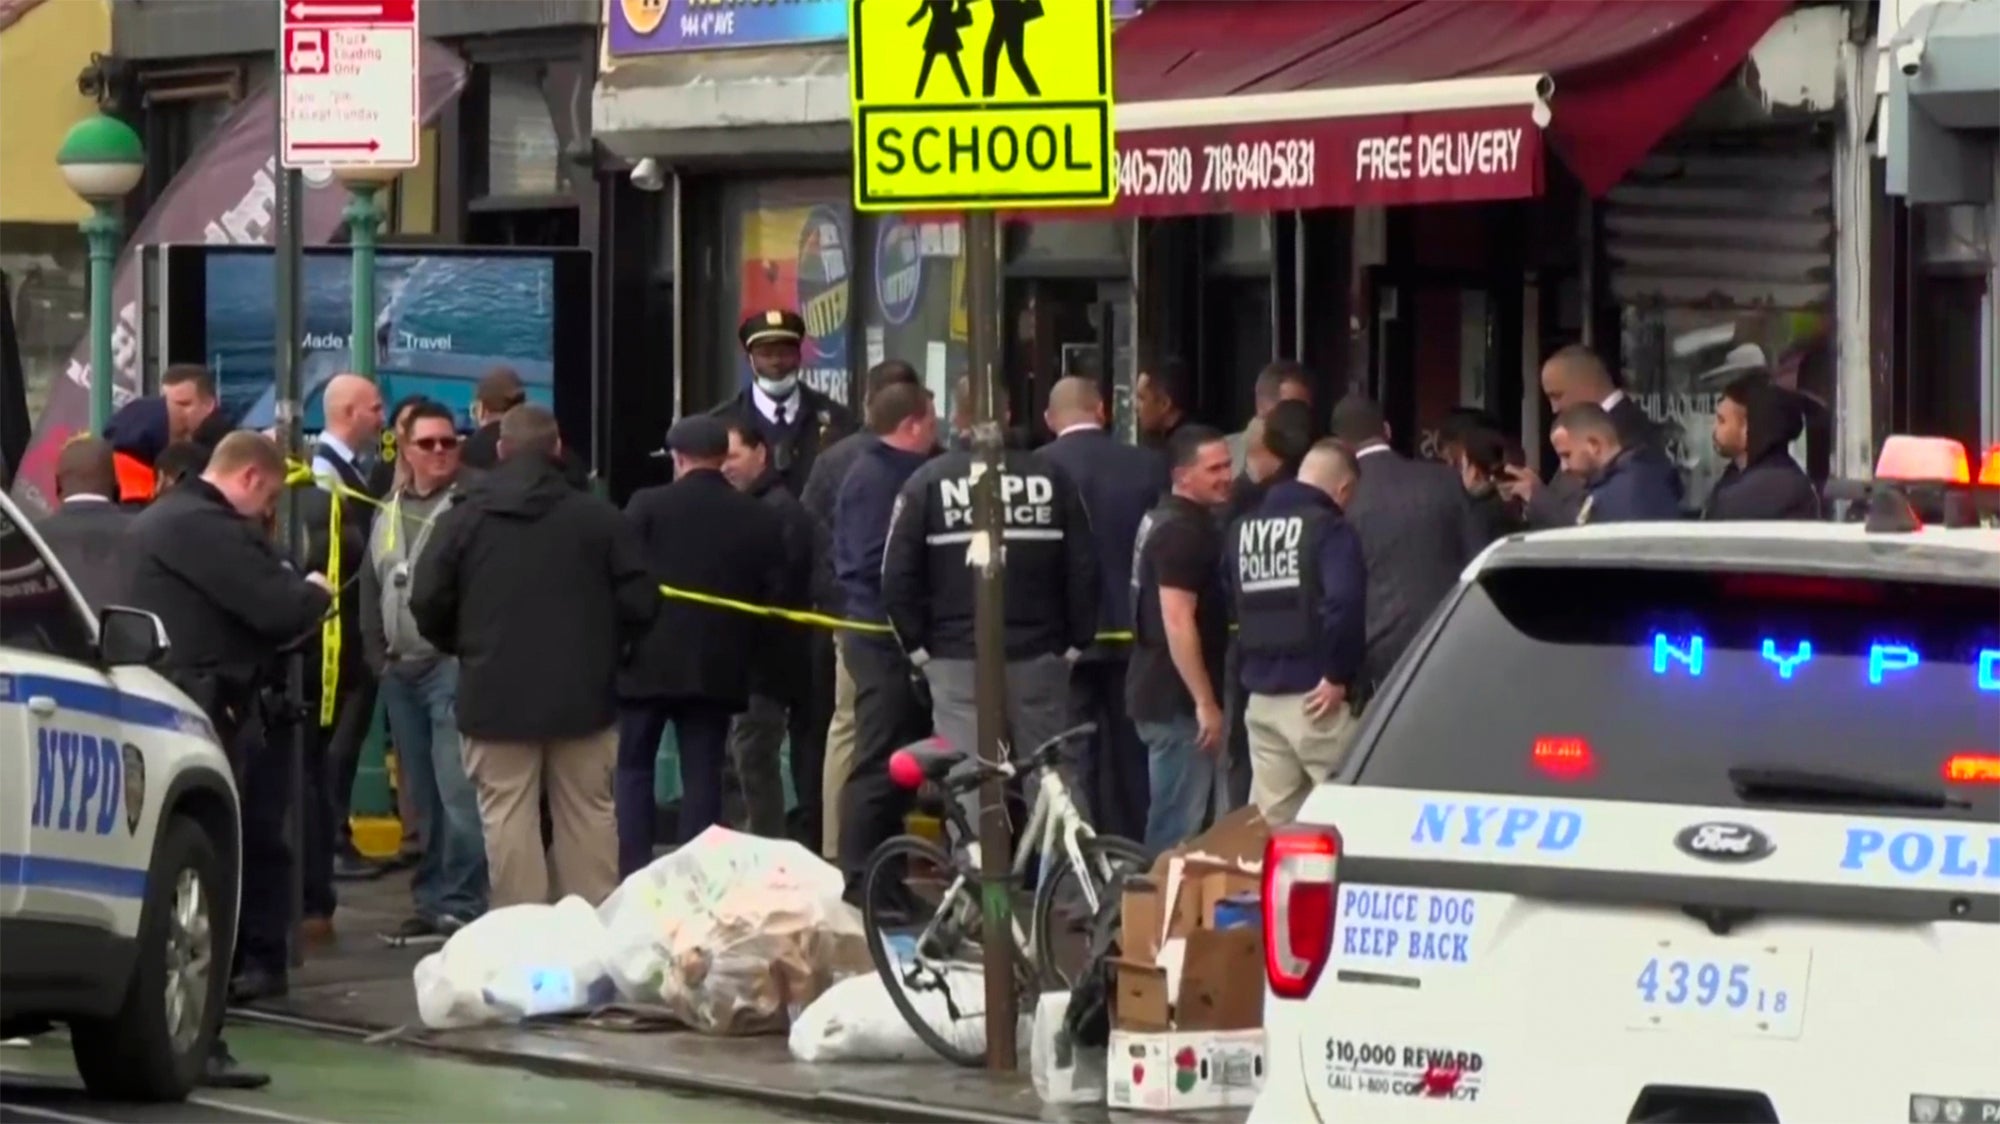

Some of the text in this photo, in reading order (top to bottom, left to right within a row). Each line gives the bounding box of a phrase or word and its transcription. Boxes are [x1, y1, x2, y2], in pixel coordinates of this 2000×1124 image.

[334, 31, 367, 45] Truck
[679, 15, 699, 37] 944
[714, 11, 735, 35] AVE
[334, 47, 382, 61] Loading
[334, 62, 361, 76] Only
[876, 123, 1093, 176] SCHOOL
[1356, 135, 1413, 182] FREE
[1417, 128, 1523, 179] DELIVERY
[405, 334, 452, 350] Travel
[940, 474, 1053, 508] NPD
[944, 505, 1053, 528] PICE
[1239, 516, 1303, 554] NYPD
[1239, 548, 1300, 583] POLICE
[31, 726, 122, 836] NYPD
[1411, 803, 1582, 851] NYPD
[1691, 825, 1753, 854] Ford
[1344, 890, 1475, 926] POLICE DOG
[1344, 926, 1469, 962] KEEP BACK
[1637, 958, 1788, 1014] 4395 18
[1326, 1037, 1483, 1073] $10,000 REWARD
[1327, 1073, 1353, 1091] CALL
